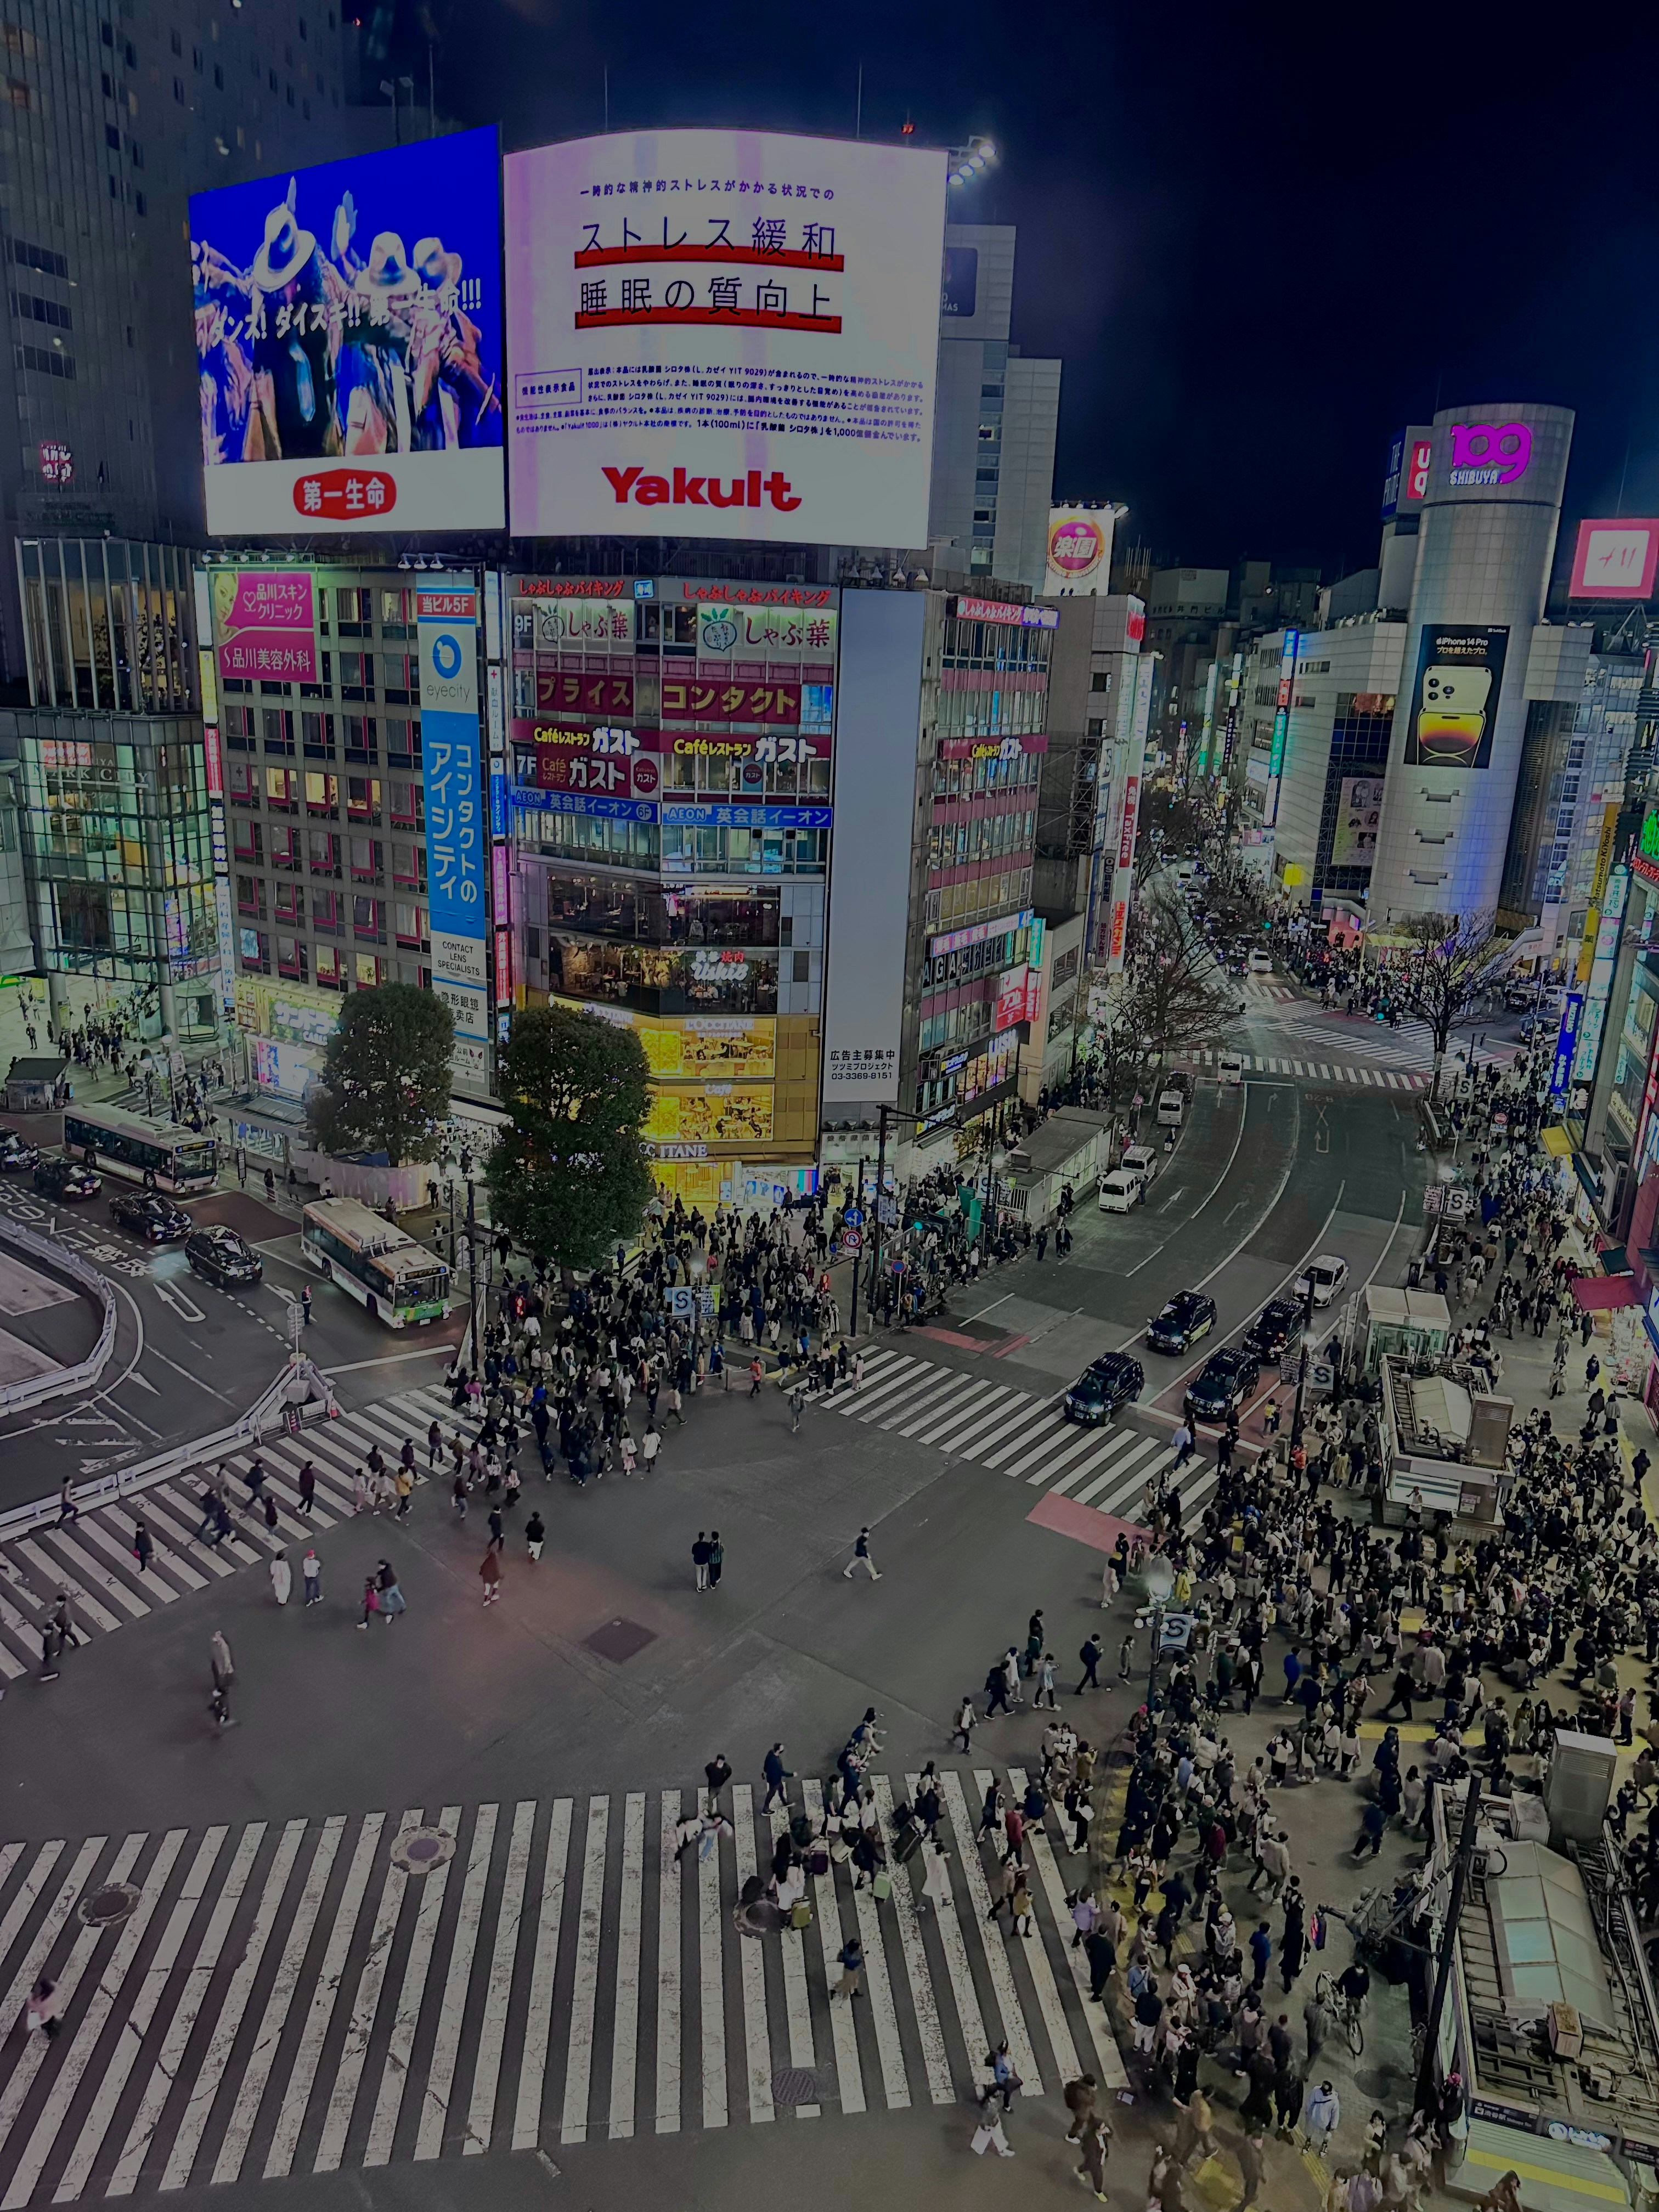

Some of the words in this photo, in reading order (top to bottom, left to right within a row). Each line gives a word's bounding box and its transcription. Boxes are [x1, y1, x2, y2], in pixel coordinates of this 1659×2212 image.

[580, 179, 834, 200] 一時的な精神的ストレスがかかる状況での
[581, 217, 835, 260] ストレス緩和
[581, 277, 832, 322] 睡眠の質向上
[729, 367, 742, 375] YIT
[522, 381, 575, 396] 機能性表示食品
[1450, 422, 1532, 484] 109
[1449, 469, 1499, 486] SHIBUYA
[303, 477, 386, 512] 第一生命
[601, 467, 802, 511] Yakult
[1053, 535, 1097, 558] 楽園
[256, 583, 307, 601] 品川スキン
[519, 579, 625, 597] しゃぶしゃぶバイキング
[684, 582, 832, 607] しゃぶしゃぶバイキング
[258, 604, 303, 620] クリニック
[422, 596, 469, 613] 当ビル5F
[1177, 606, 1224, 614] 井門ビル
[515, 615, 532, 633] 9F
[569, 611, 628, 640] しゃぶ葉
[746, 617, 830, 648] しゃぶ葉
[1442, 637, 1466, 646] iPhone
[1476, 638, 1488, 646] Pro
[233, 648, 311, 673] 品川美容外科
[427, 682, 470, 702] eyecity
[538, 675, 631, 707] プライス
[663, 686, 798, 715] コンタクト
[592, 727, 640, 755] ガスト
[754, 736, 817, 763] ガスト
[517, 754, 537, 775] 7F
[542, 758, 566, 772] Café
[569, 757, 625, 790] ガスト
[543, 773, 566, 783] レストラン
[636, 774, 656, 783] ガスト
[515, 792, 541, 806] AEON
[550, 793, 632, 816] 英会話イーオン
[637, 806, 651, 818] 6F
[429, 742, 456, 899] アイシティ
[456, 744, 477, 903] コンタクトの
[668, 808, 706, 821] AEON
[716, 808, 828, 825] 英会話イーオン
[1105, 857, 1114, 873] OS
[1594, 859, 1606, 902] atsumoto
[1600, 826, 1612, 857] KiYoshi
[1021, 910, 1033, 927] 4F
[443, 941, 473, 954] CONTACT
[450, 953, 466, 963] LENS
[438, 960, 480, 976] SPECIALISTS
[441, 991, 479, 1011] 隐形眼镜
[1566, 1001, 1578, 1034] MIZUHO
[989, 1029, 1018, 1055] LUSH
[831, 1049, 895, 1060] 広告主募集中
[675, 1289, 690, 1310] S
